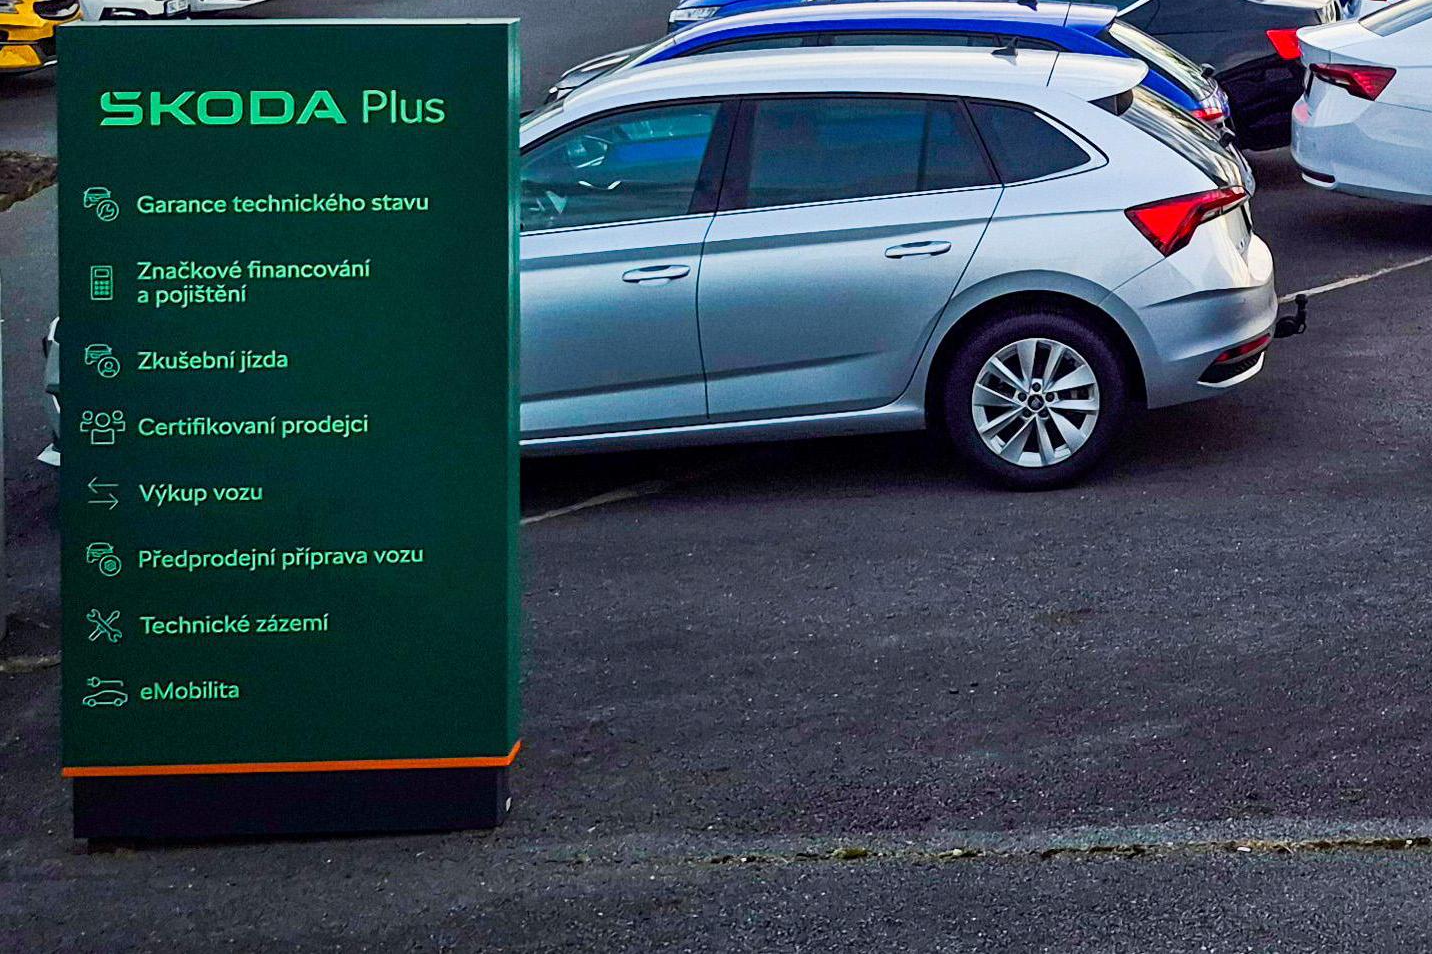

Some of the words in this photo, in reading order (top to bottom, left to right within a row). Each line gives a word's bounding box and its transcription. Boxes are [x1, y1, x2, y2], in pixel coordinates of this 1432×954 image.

[363, 90, 445, 123] Plus
[137, 196, 226, 213] Garance
[232, 193, 365, 212] technického
[372, 195, 428, 210] stavu
[137, 261, 241, 279] Značkové
[247, 259, 370, 278] financování
[138, 290, 148, 303] a
[156, 284, 246, 308] pojištění
[138, 351, 235, 369] Zkušební
[239, 350, 288, 372] jízda
[139, 416, 275, 435] Certifikovaní
[282, 414, 368, 438] prodejci
[139, 482, 207, 506] Výkup
[213, 488, 262, 500] vozu
[140, 548, 275, 572] Předprodejní
[282, 546, 367, 570] příprava
[374, 550, 423, 563] vozu
[140, 615, 250, 634] Technické
[256, 613, 328, 632] zázemí
[141, 681, 239, 699] eMobilita
